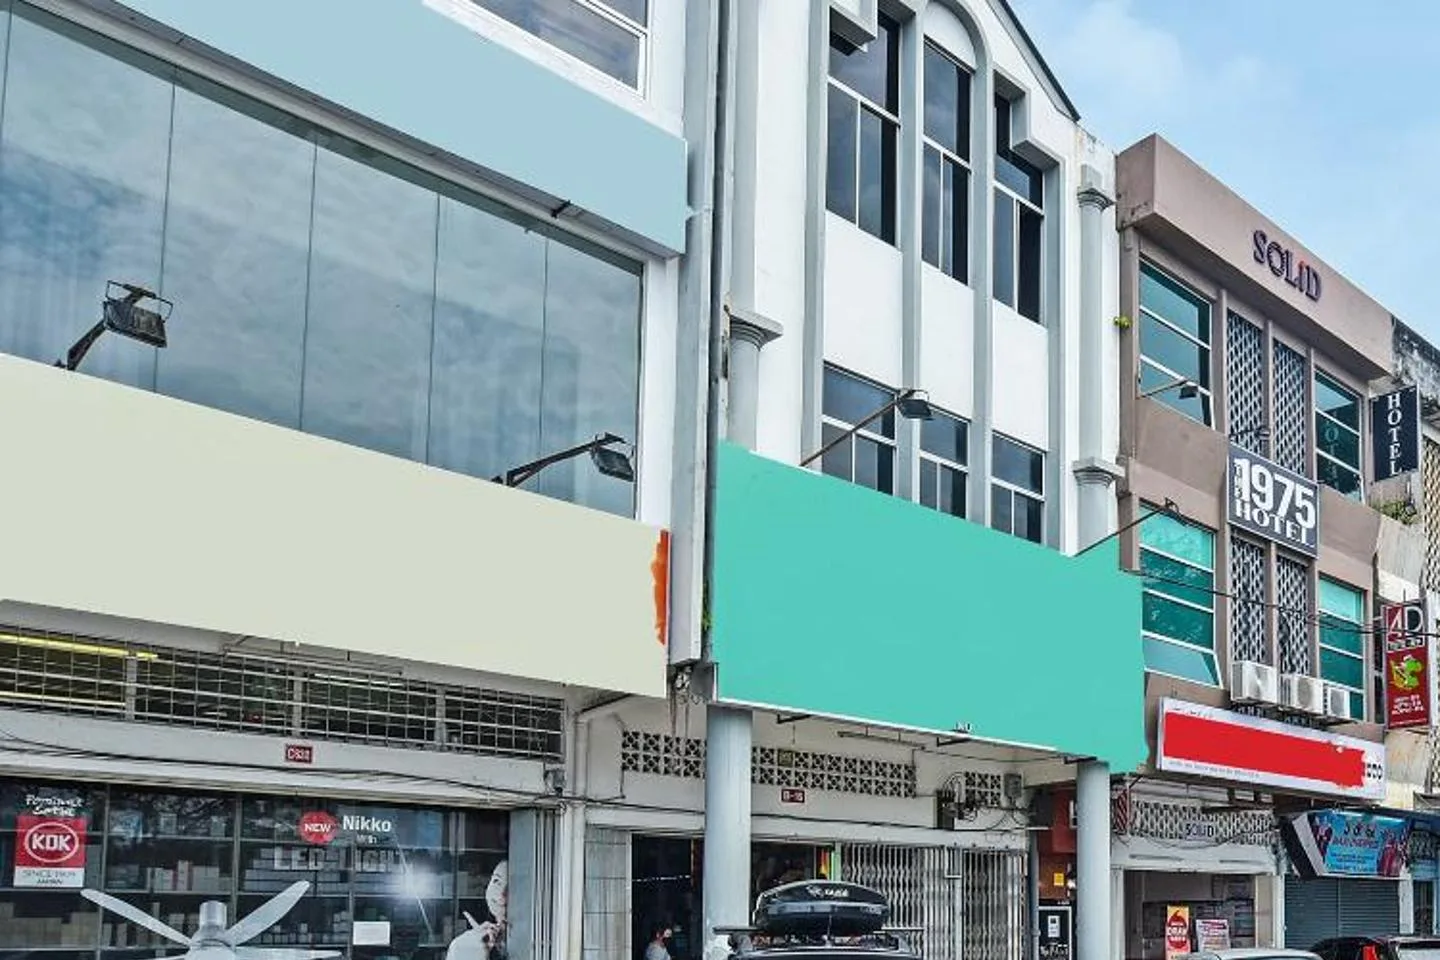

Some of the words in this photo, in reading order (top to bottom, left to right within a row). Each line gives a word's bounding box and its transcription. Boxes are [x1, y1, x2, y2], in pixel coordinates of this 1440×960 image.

[1387, 393, 1403, 476] HOTEL
[1241, 458, 1316, 529] 1975
[1235, 499, 1316, 548] HOTEL
[304, 823, 331, 833] NEW
[342, 815, 392, 832] Nikko
[32, 833, 72, 852] KDK
